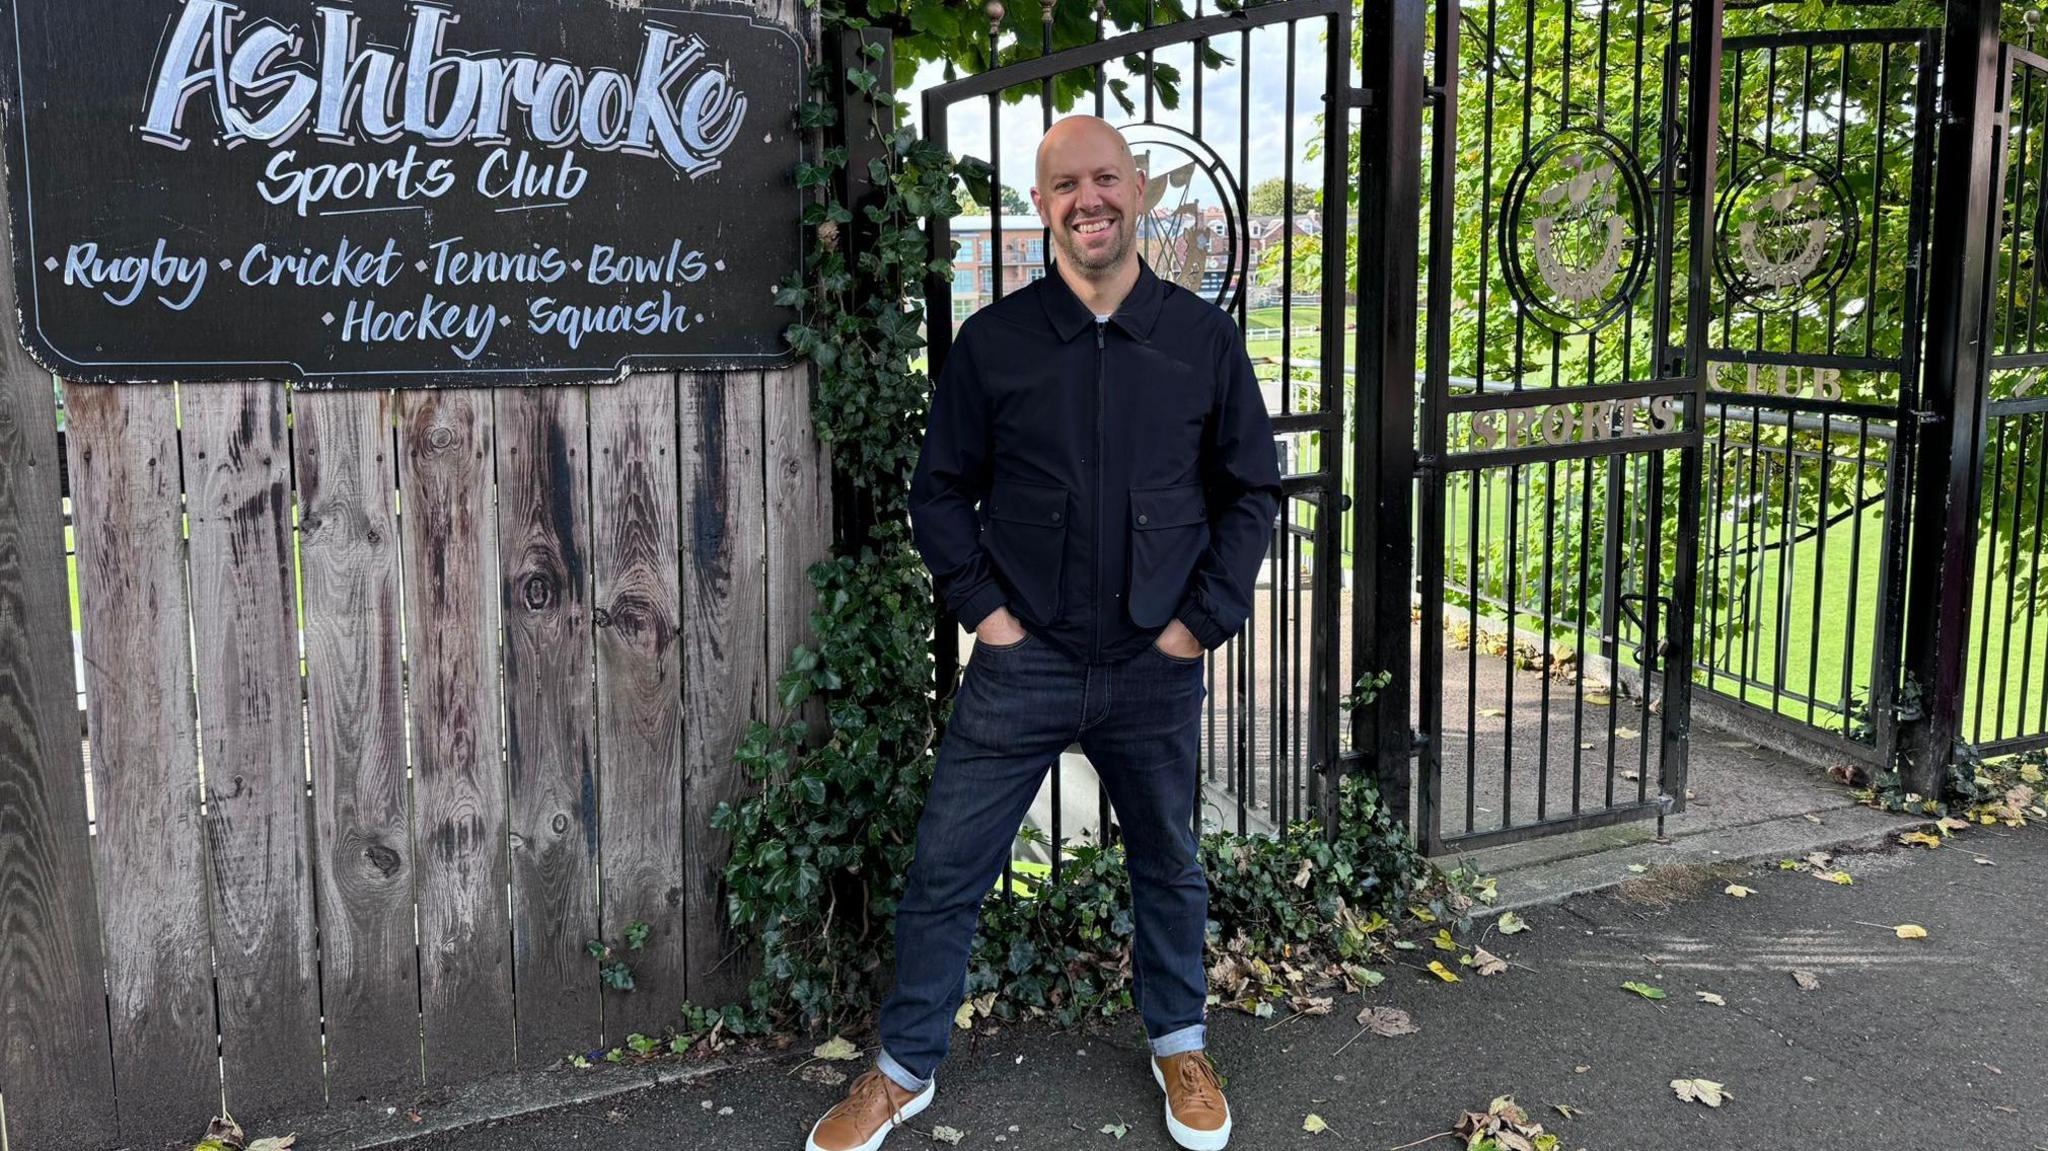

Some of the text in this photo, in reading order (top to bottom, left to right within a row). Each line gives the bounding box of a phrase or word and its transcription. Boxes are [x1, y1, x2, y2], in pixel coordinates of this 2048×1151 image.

[257, 146, 587, 216] Sports Club
[64, 236, 707, 310] Rugby Cricket Tennis Bowls
[341, 289, 690, 360] Hockey Squash
[1707, 360, 1842, 401] CLUB
[1472, 396, 1676, 450] SPORTS
